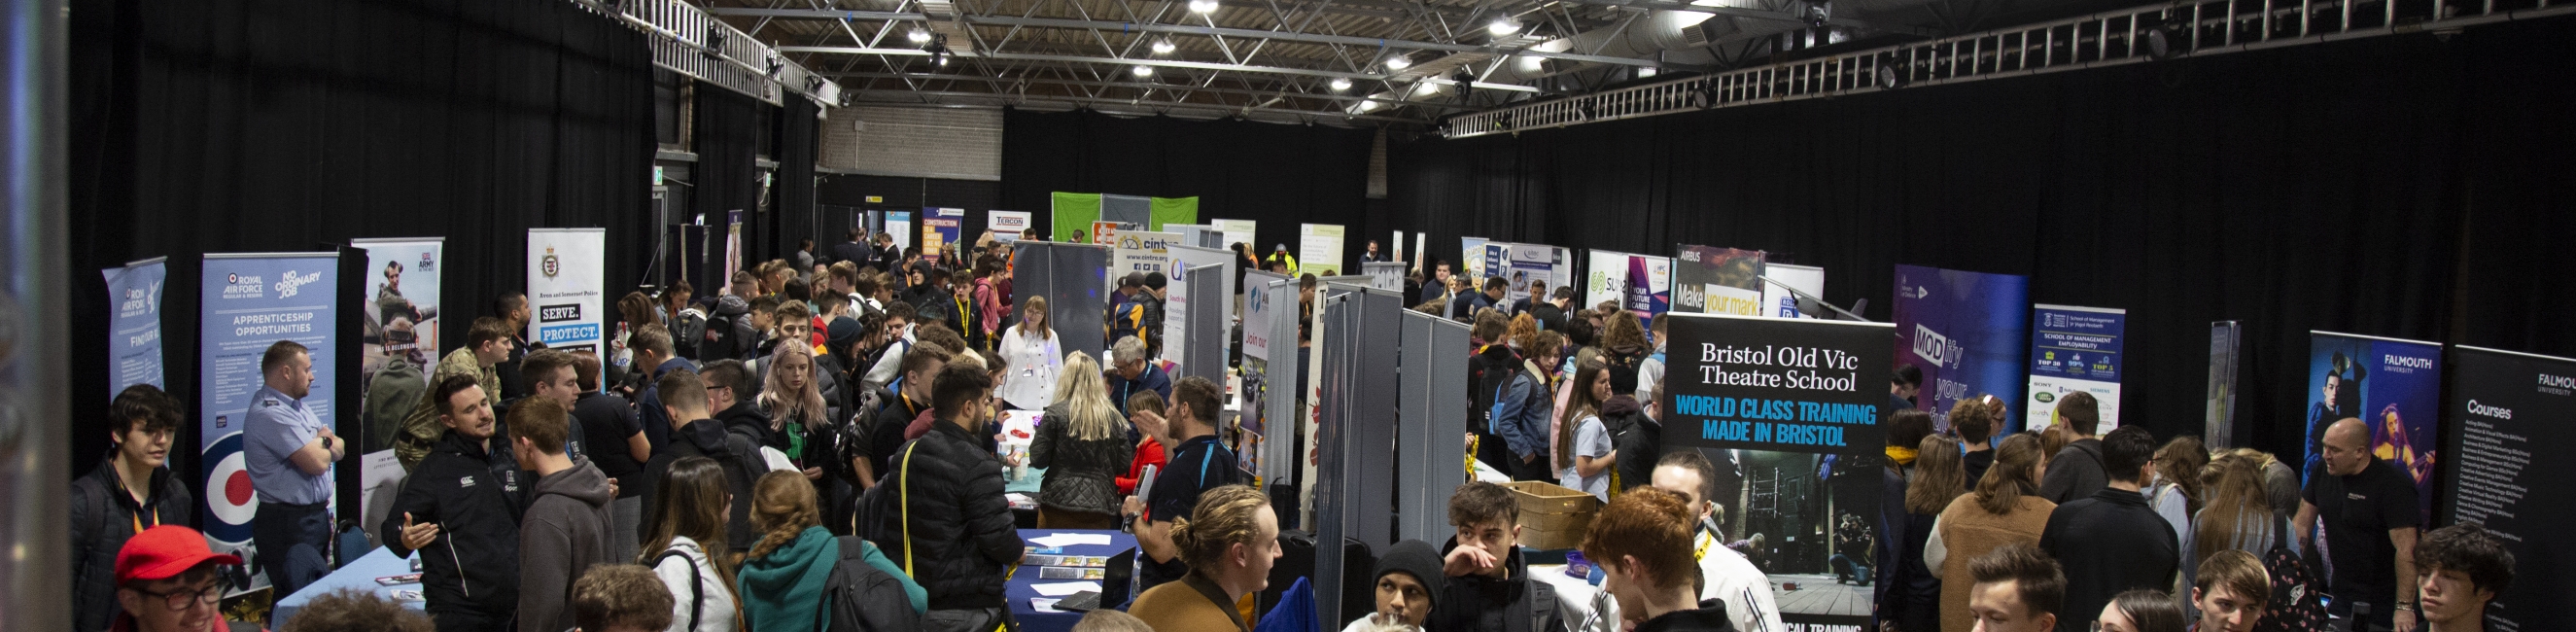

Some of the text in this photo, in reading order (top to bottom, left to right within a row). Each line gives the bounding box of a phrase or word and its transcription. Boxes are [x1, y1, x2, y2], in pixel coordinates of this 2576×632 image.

[1681, 250, 1700, 262] AIRBUS
[275, 271, 321, 291] ORDINARY
[283, 270, 296, 281] NO
[224, 284, 262, 294] AIR FORCE
[279, 287, 297, 299] JOB
[1632, 295, 1650, 303] FUTURE
[1677, 283, 1758, 316] Make your mark
[1632, 302, 1650, 311] CAREER
[233, 312, 313, 325] APPRENTICESHIP
[543, 307, 579, 320] SERVE.
[236, 323, 311, 336] OPPORTUNITIES
[543, 326, 597, 341] PROTECT.
[2058, 341, 2098, 350] EMPLOYABILITY
[1700, 342, 1858, 370] Bristol Old Vic
[2385, 354, 2432, 369] FALMOUTH
[2384, 365, 2413, 374] UNIVERSITY
[1700, 365, 1857, 392] Theatre School
[1934, 378, 1967, 401] your
[2538, 386, 2571, 397] UNIVERSITY
[1675, 395, 1877, 425] WORLD CLASS TRAINING
[2467, 399, 2512, 420] Courses
[1702, 420, 1847, 447] MADE IN BRISTOL
